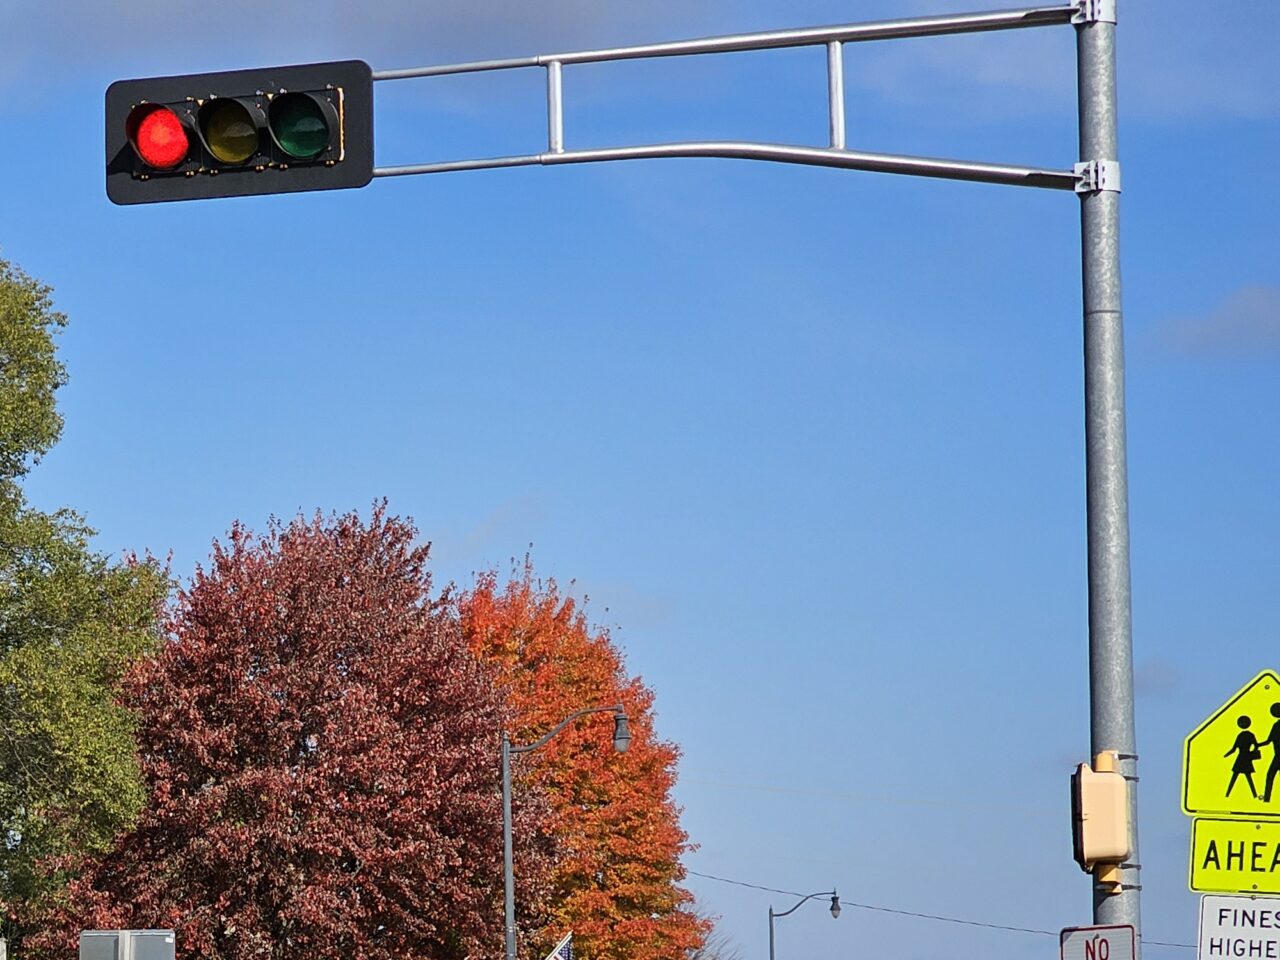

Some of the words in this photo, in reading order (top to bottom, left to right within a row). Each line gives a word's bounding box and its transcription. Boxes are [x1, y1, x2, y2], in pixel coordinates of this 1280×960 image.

[1202, 839, 1280, 873] AHEA
[1218, 908, 1280, 929] FINES
[1209, 937, 1280, 958] HIGHE
